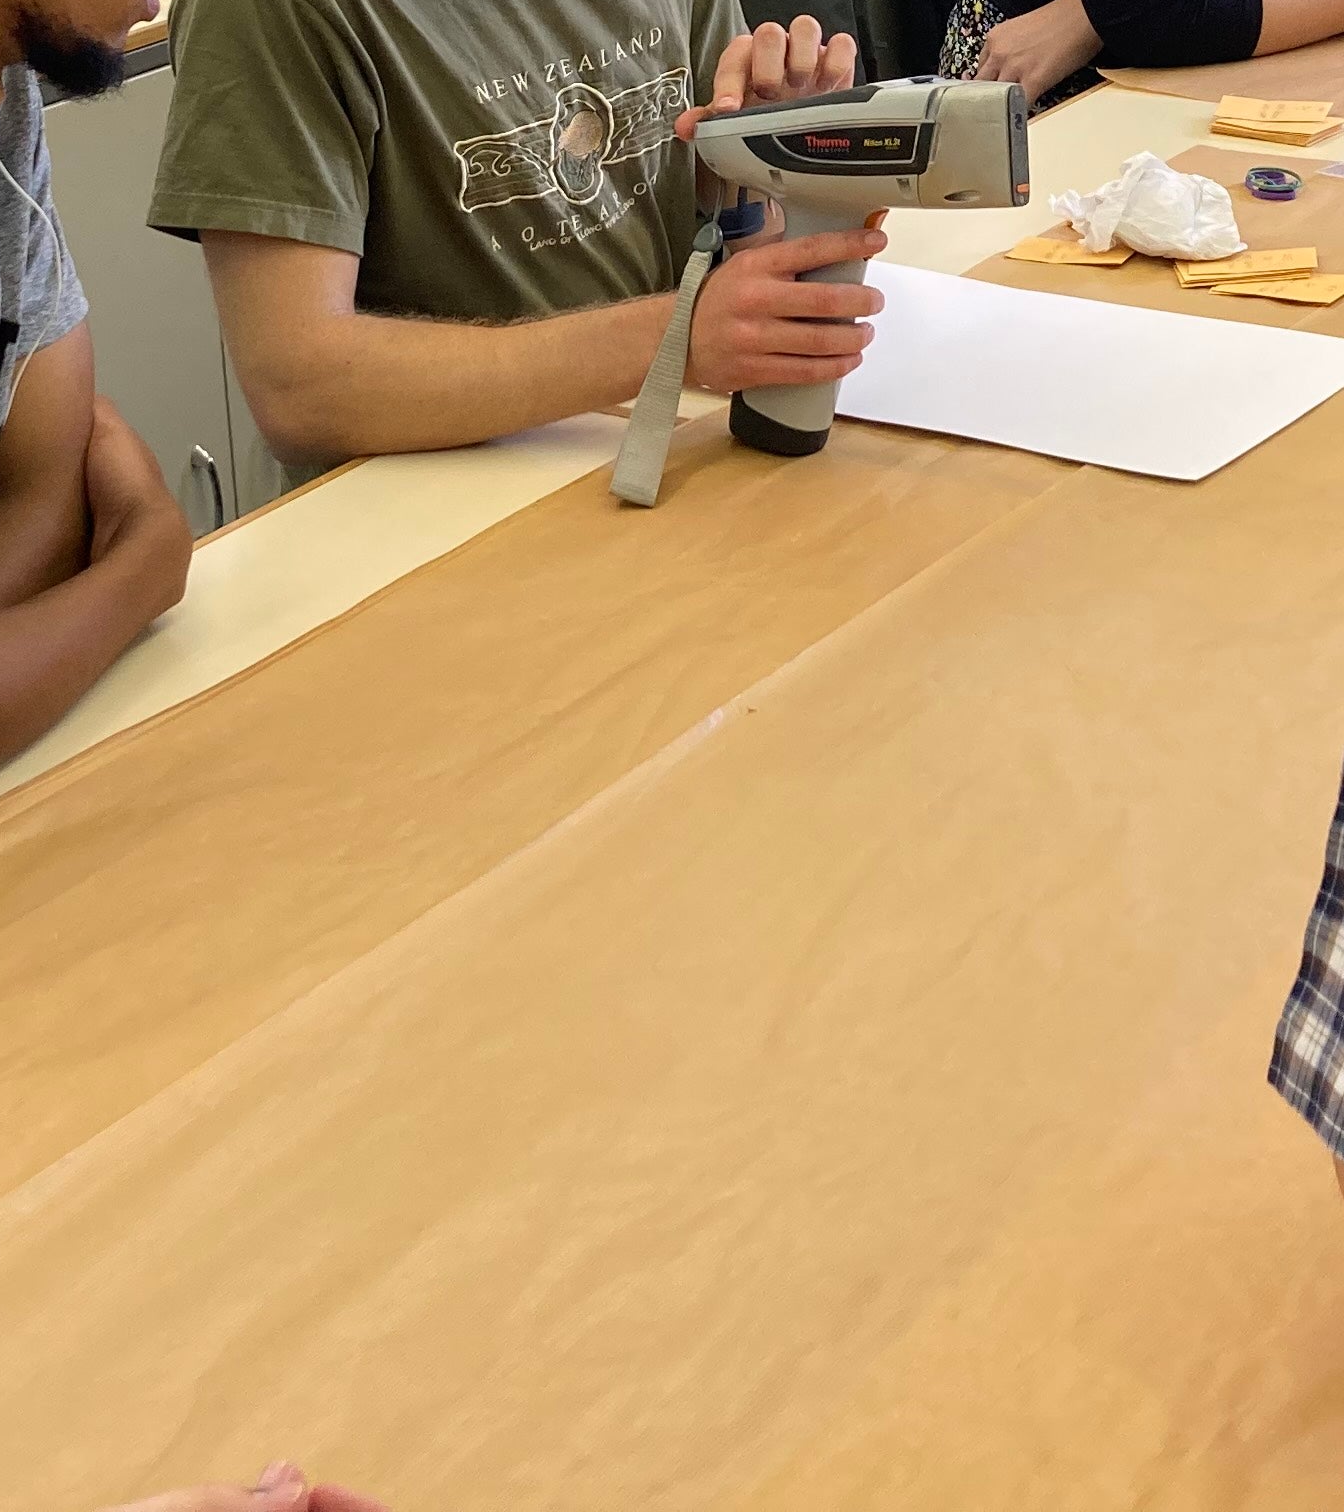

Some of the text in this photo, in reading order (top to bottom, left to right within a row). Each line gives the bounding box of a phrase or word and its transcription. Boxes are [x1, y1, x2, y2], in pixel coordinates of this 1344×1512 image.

[475, 26, 663, 105] NEW ZEALAND
[805, 135, 851, 148] Thermo
